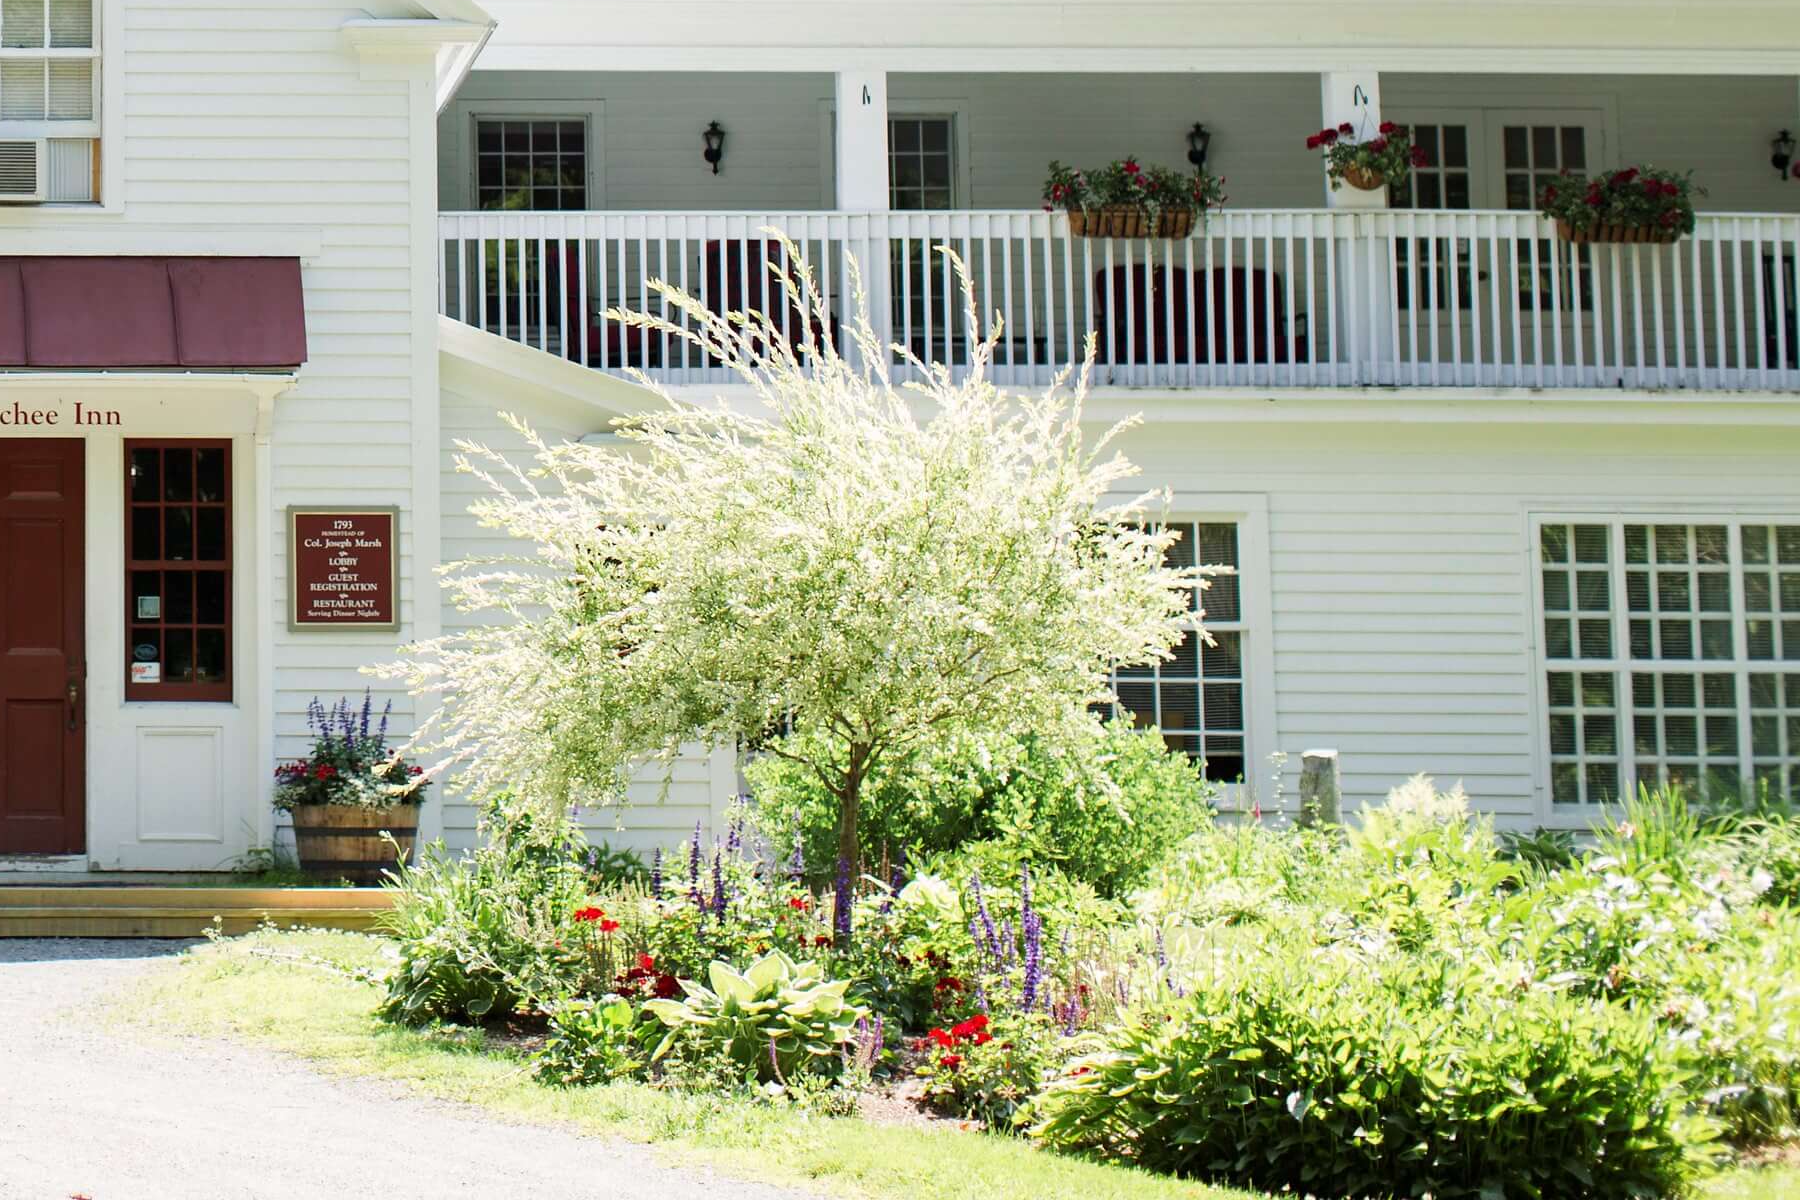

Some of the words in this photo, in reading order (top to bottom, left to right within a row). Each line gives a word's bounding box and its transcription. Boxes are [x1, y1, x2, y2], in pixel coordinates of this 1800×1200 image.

[74, 402, 122, 425] Inn
[333, 520, 353, 529] 1793
[304, 539, 322, 547] Col.
[325, 539, 352, 549] Joseph
[355, 539, 382, 547] Marsh
[329, 558, 358, 566] LOBBY
[328, 574, 359, 582] GUEST
[310, 583, 377, 591] REGISTRATION
[313, 600, 375, 608] RESTAURANT
